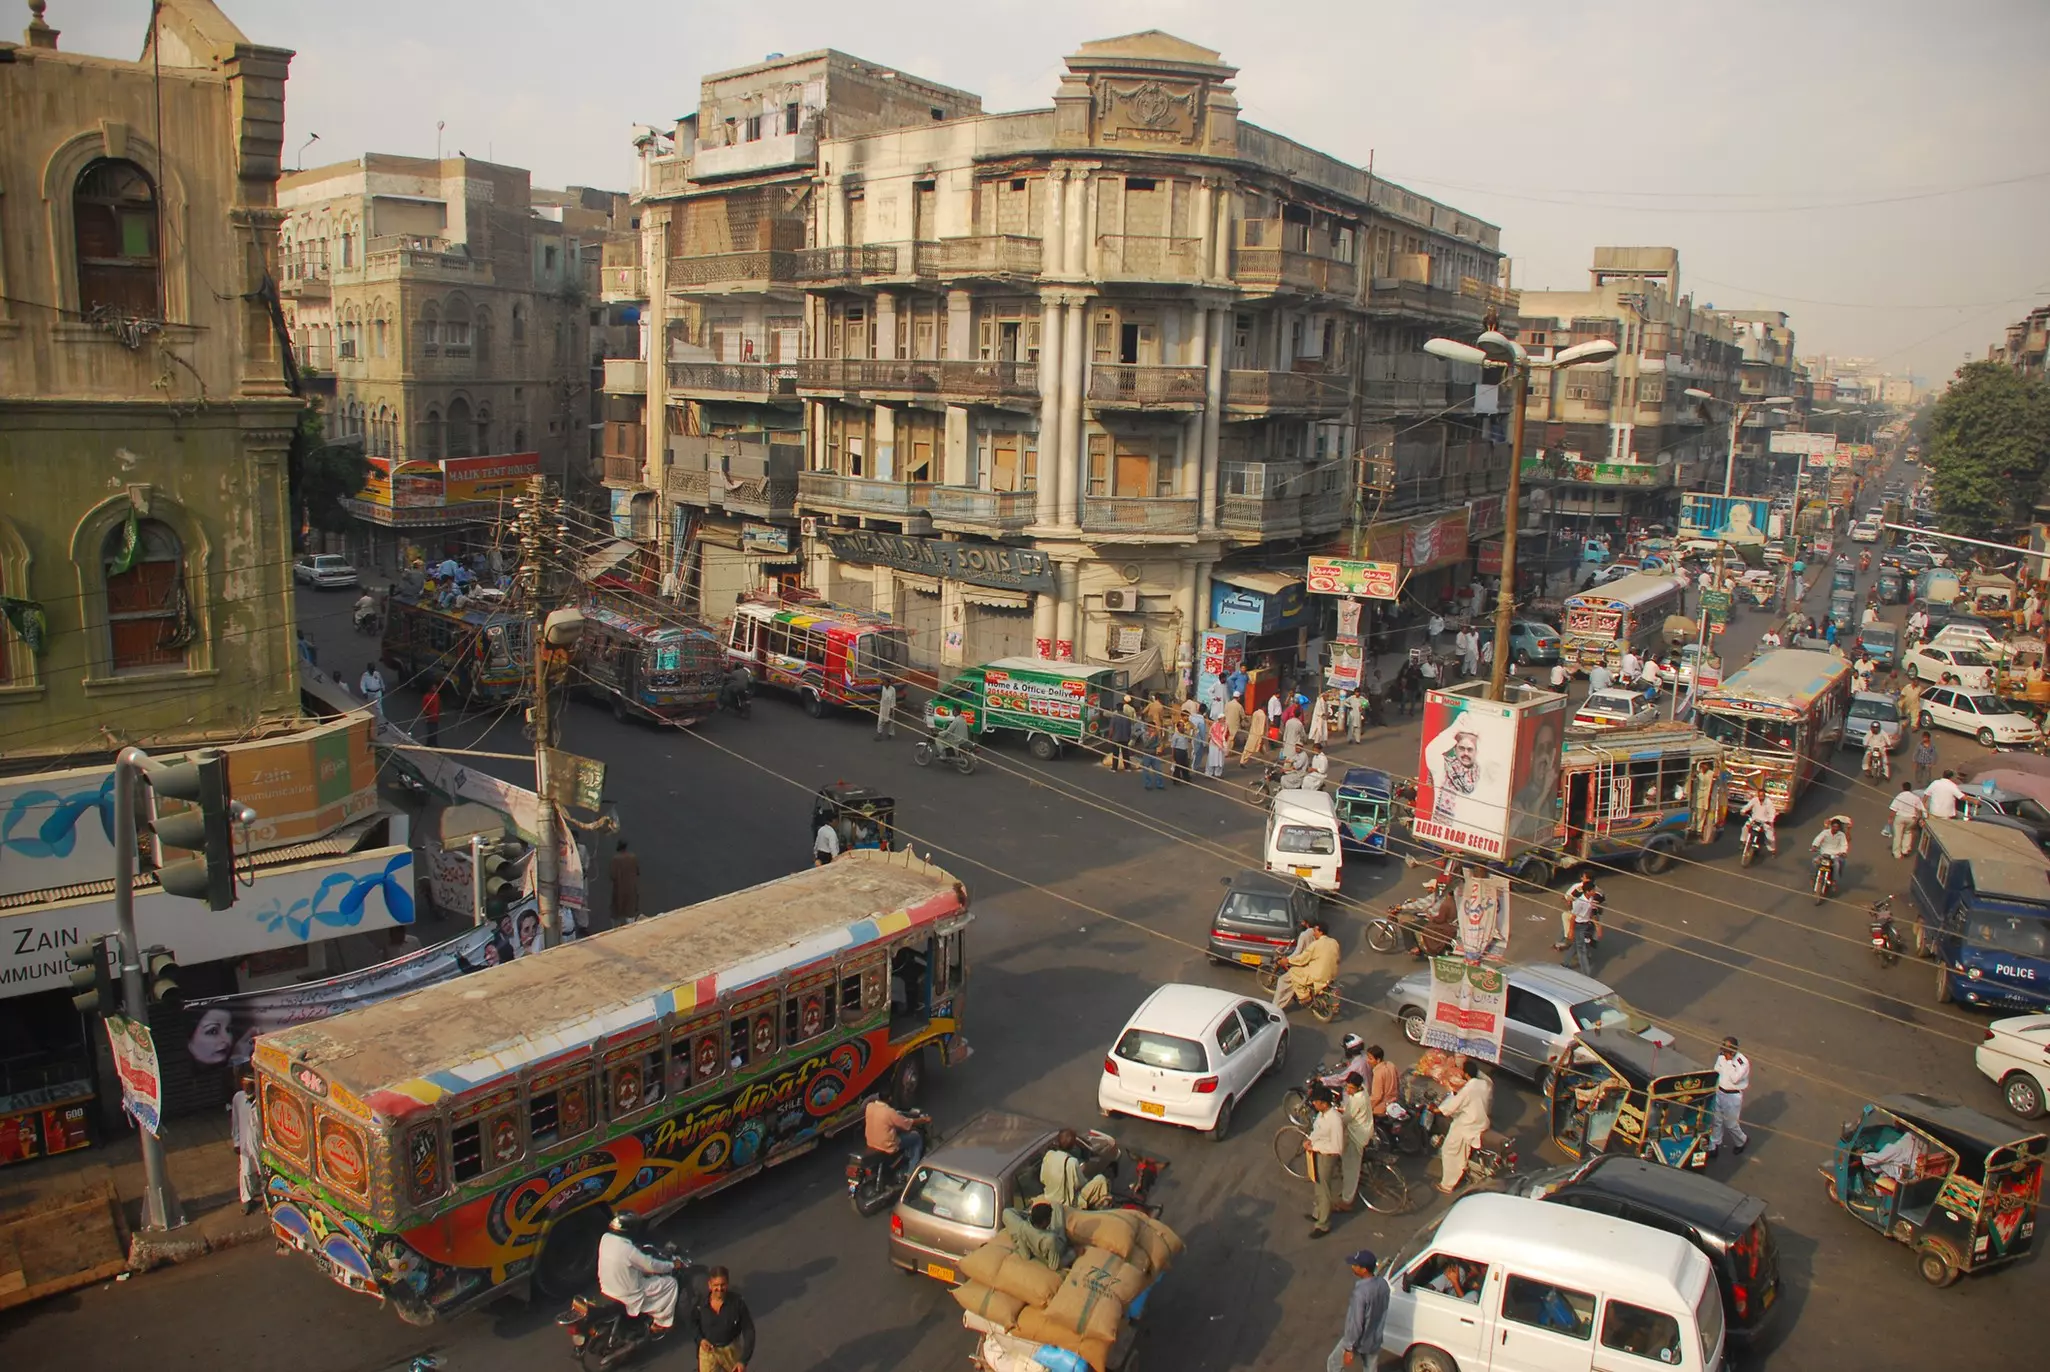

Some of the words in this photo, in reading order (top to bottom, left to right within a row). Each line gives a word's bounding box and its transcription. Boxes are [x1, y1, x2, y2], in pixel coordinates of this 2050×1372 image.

[450, 469, 481, 482] MALIK
[482, 466, 506, 479] TENT
[507, 463, 537, 476] HOUSE
[957, 548, 1010, 572] SONS
[987, 680, 1011, 691] Home
[1013, 682, 1019, 691] &
[1021, 684, 1046, 695] Office
[1048, 688, 1081, 702] Delivery
[251, 767, 292, 786] Zain
[1444, 827, 1466, 845] ROAD
[1468, 833, 1500, 854] SECTOR
[13, 927, 78, 955] ZAIN
[1995, 963, 2036, 980] POLICE
[65, 1107, 84, 1121] 600
